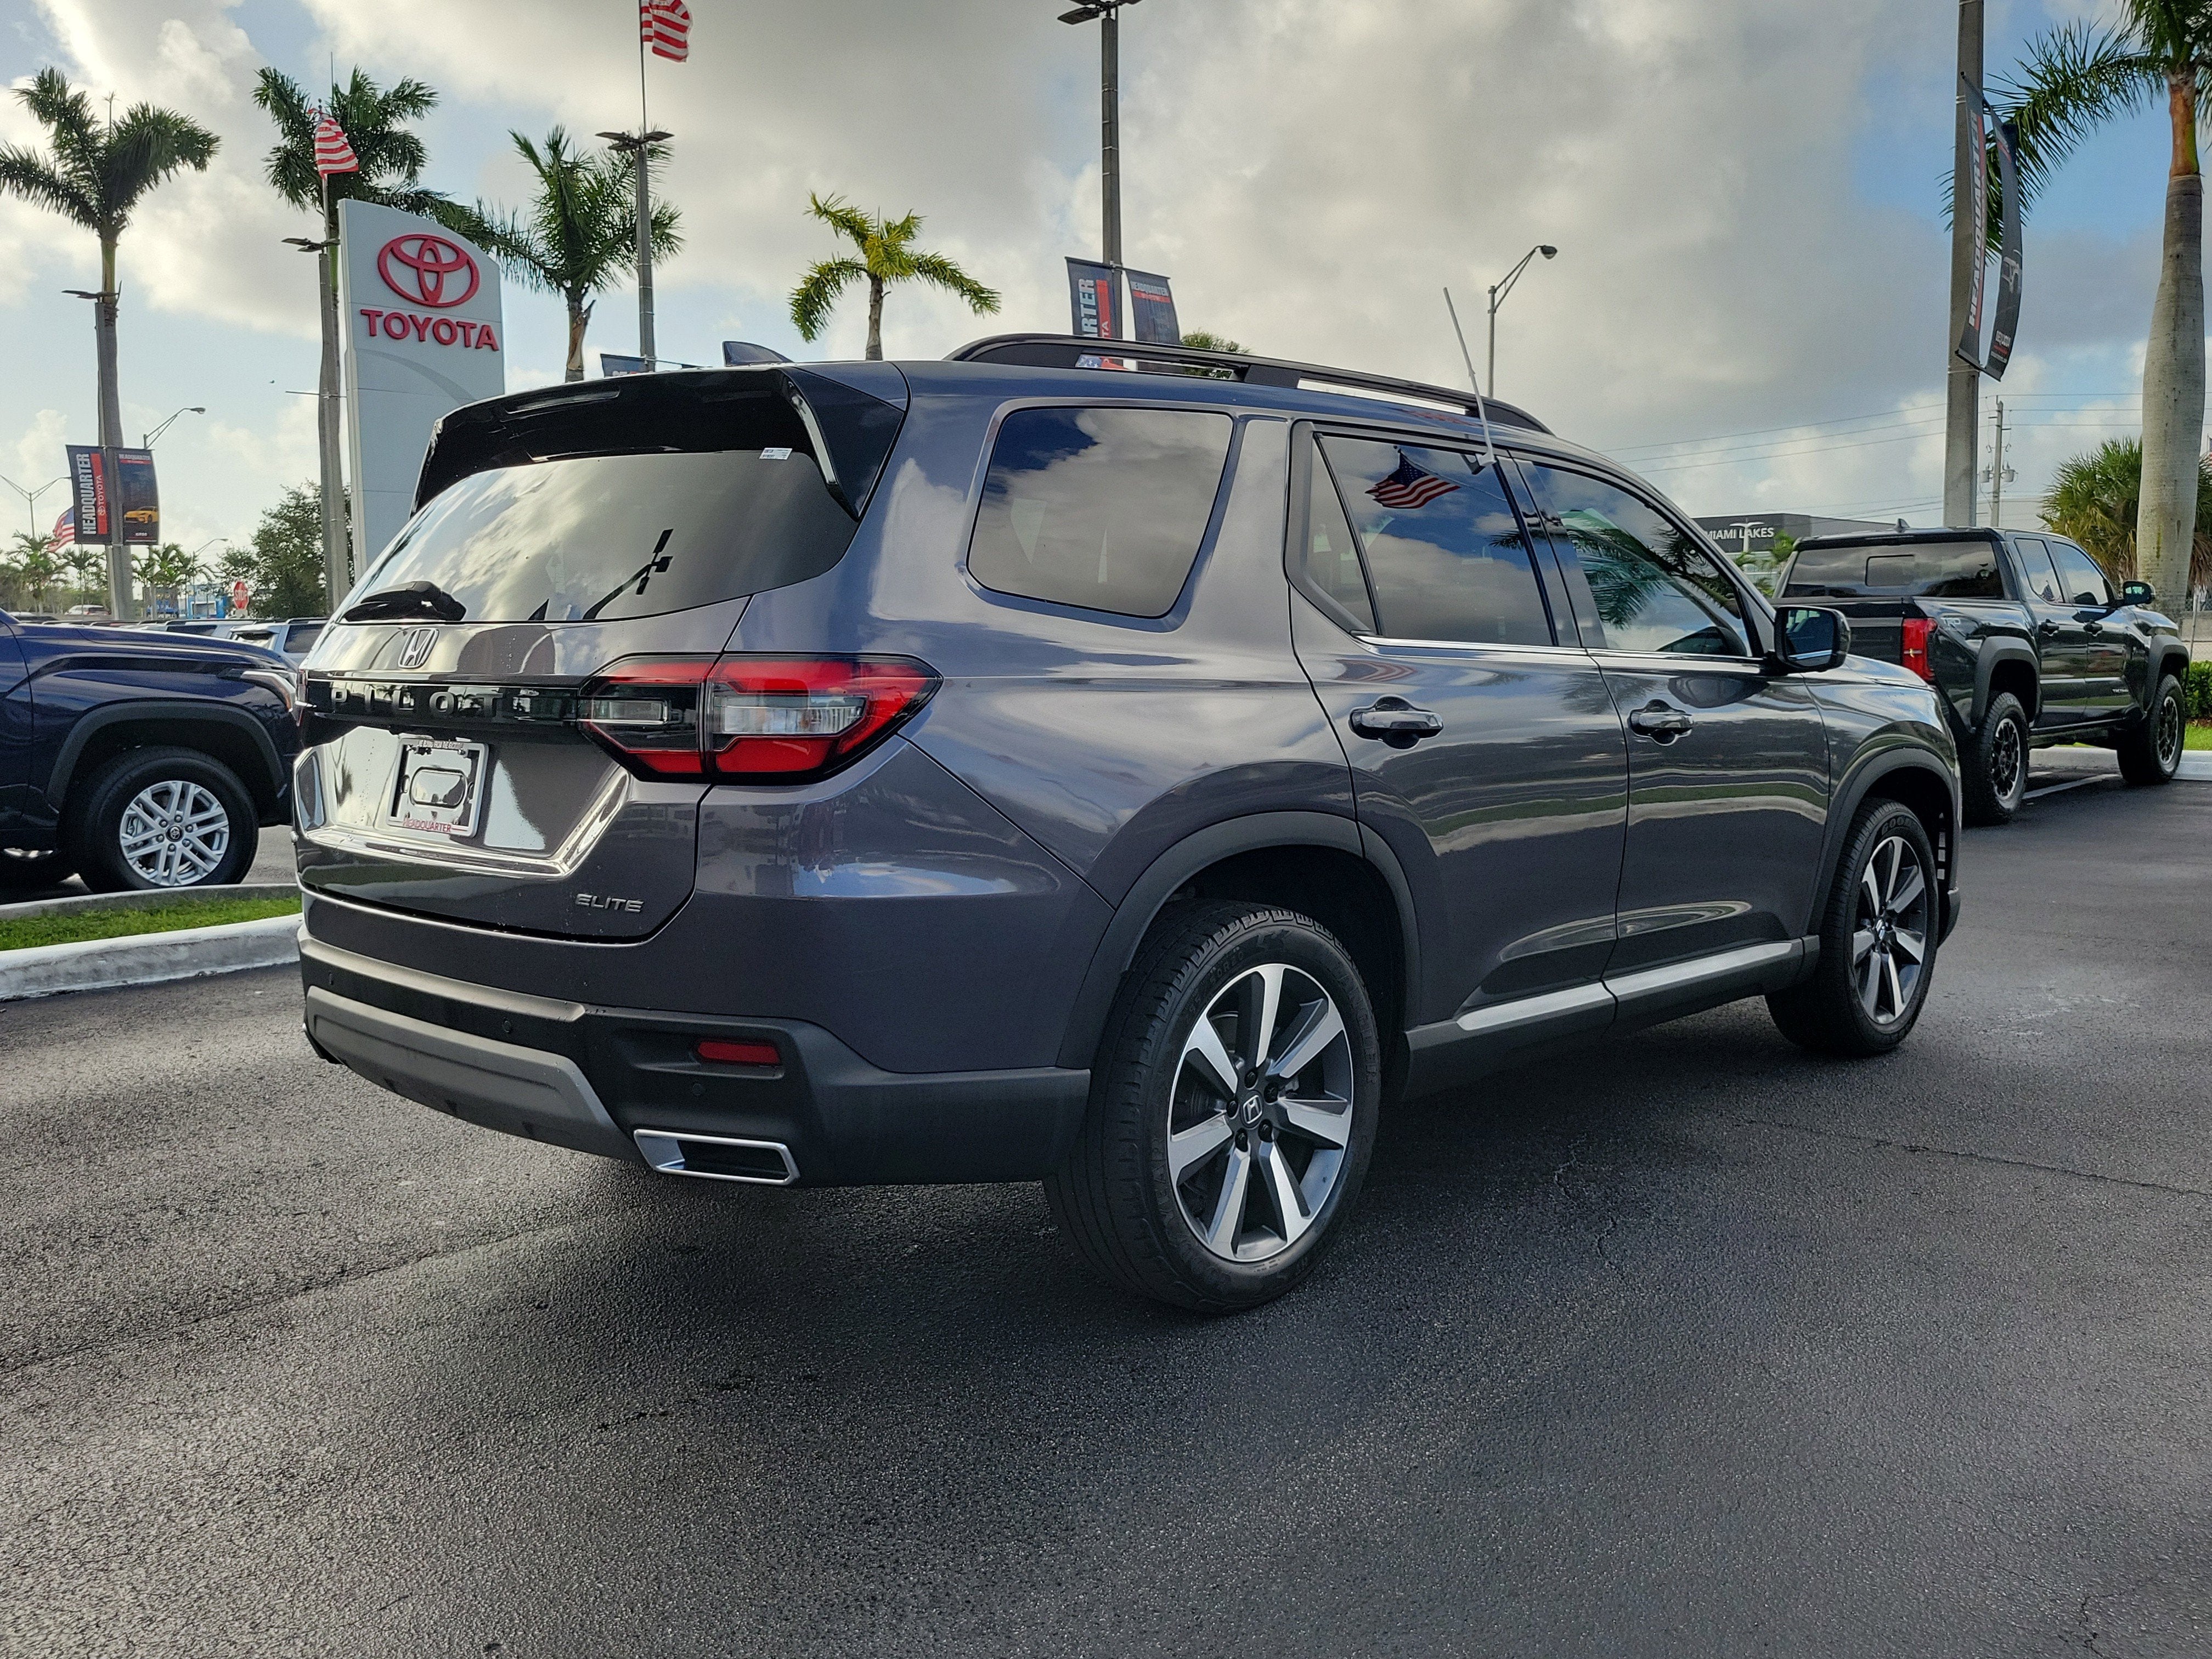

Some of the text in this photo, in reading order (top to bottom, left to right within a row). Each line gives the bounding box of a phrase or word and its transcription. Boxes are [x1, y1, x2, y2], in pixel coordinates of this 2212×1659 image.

[360, 309, 499, 352] TOYOTA
[76, 453, 97, 534] HEADQUARTER
[95, 475, 105, 505] TOYOTA
[1739, 527, 1775, 539] LAKES
[235, 590, 247, 601] STOP
[331, 685, 503, 713] PILOT
[403, 817, 452, 833] HEADQUARTER
[575, 893, 645, 912] ELITE
